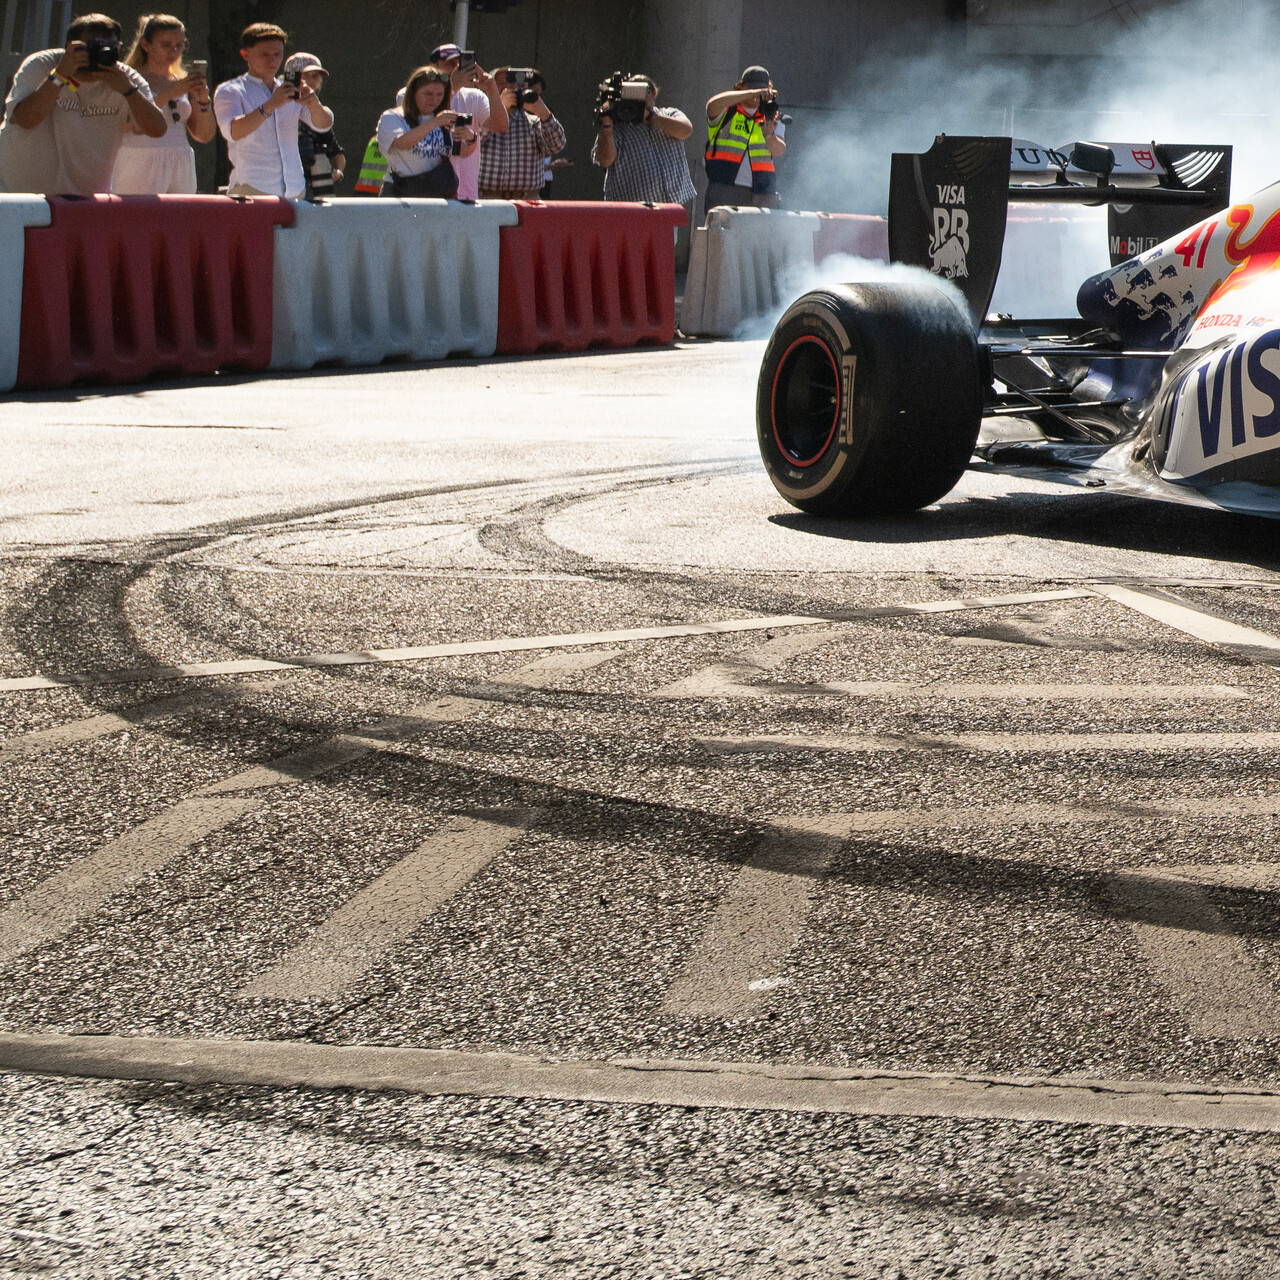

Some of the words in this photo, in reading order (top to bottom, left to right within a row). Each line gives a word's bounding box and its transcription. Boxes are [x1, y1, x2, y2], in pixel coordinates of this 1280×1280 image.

[936, 184, 965, 205] VISA
[933, 207, 970, 255] RB
[1110, 236, 1143, 255] Mobil
[1175, 222, 1218, 268] 41
[1195, 315, 1242, 331] HONDA
